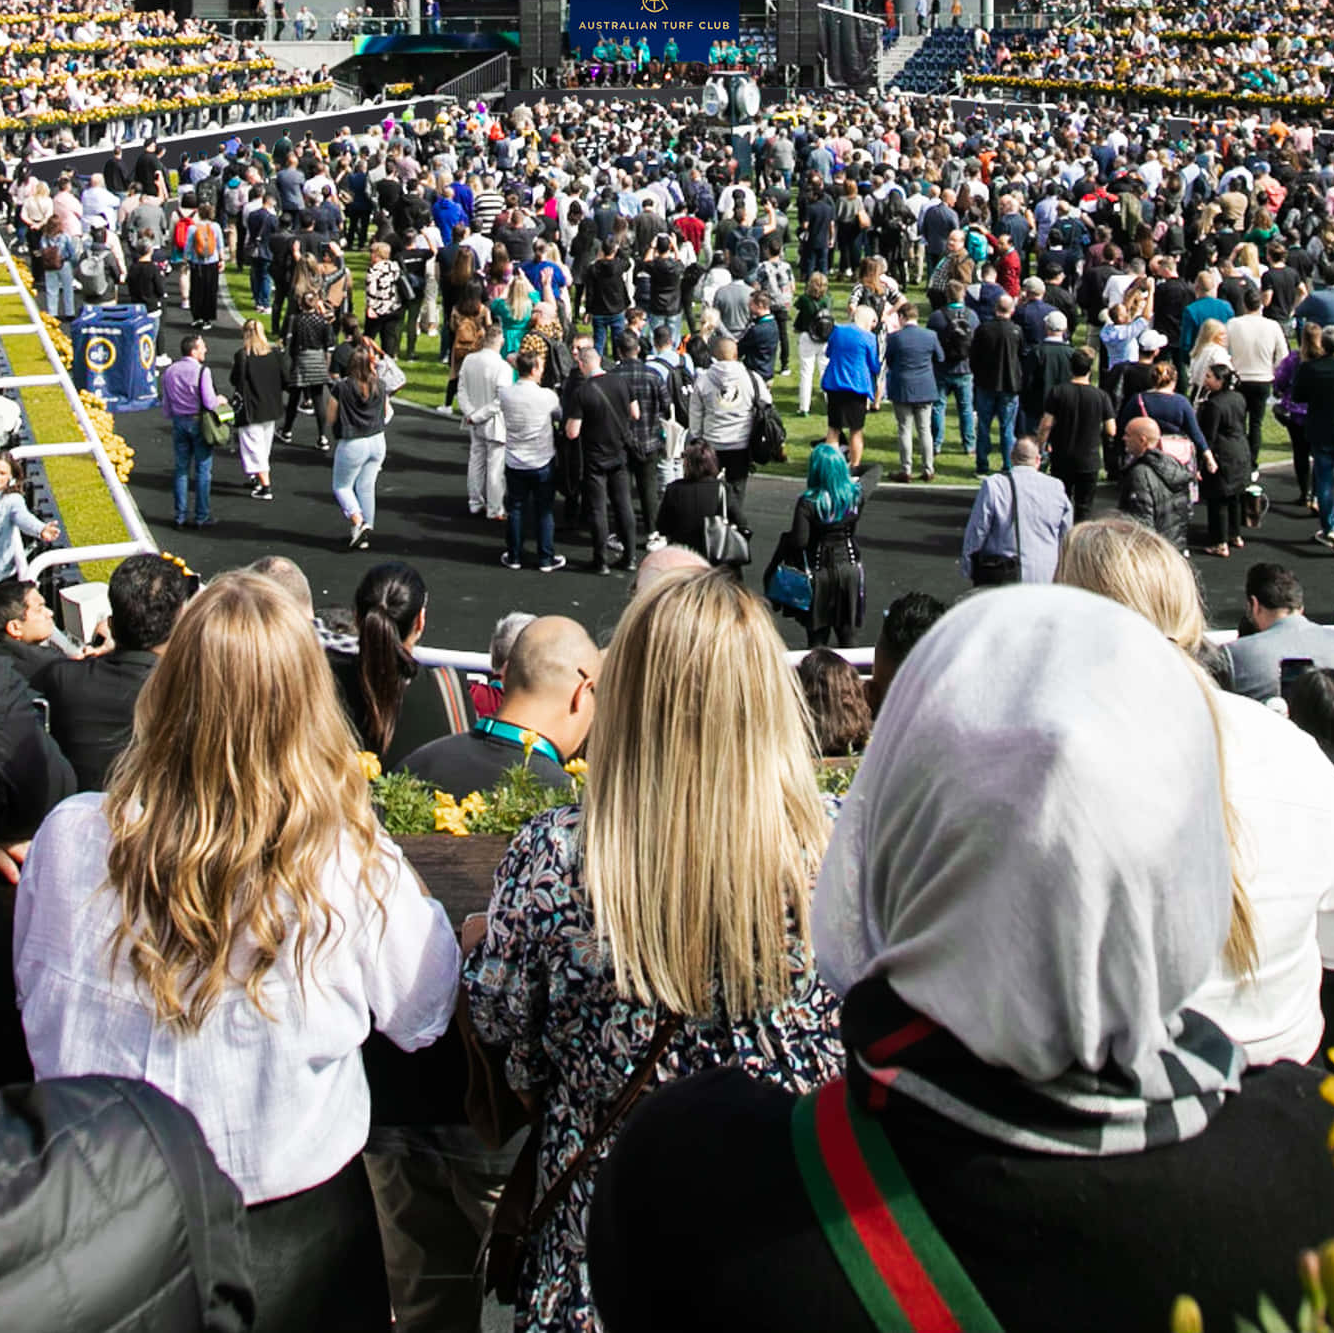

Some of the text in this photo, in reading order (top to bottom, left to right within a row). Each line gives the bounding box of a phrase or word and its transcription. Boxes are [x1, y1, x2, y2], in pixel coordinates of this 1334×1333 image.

[578, 21, 730, 30] AUSTRALIAN TURF CLUB
